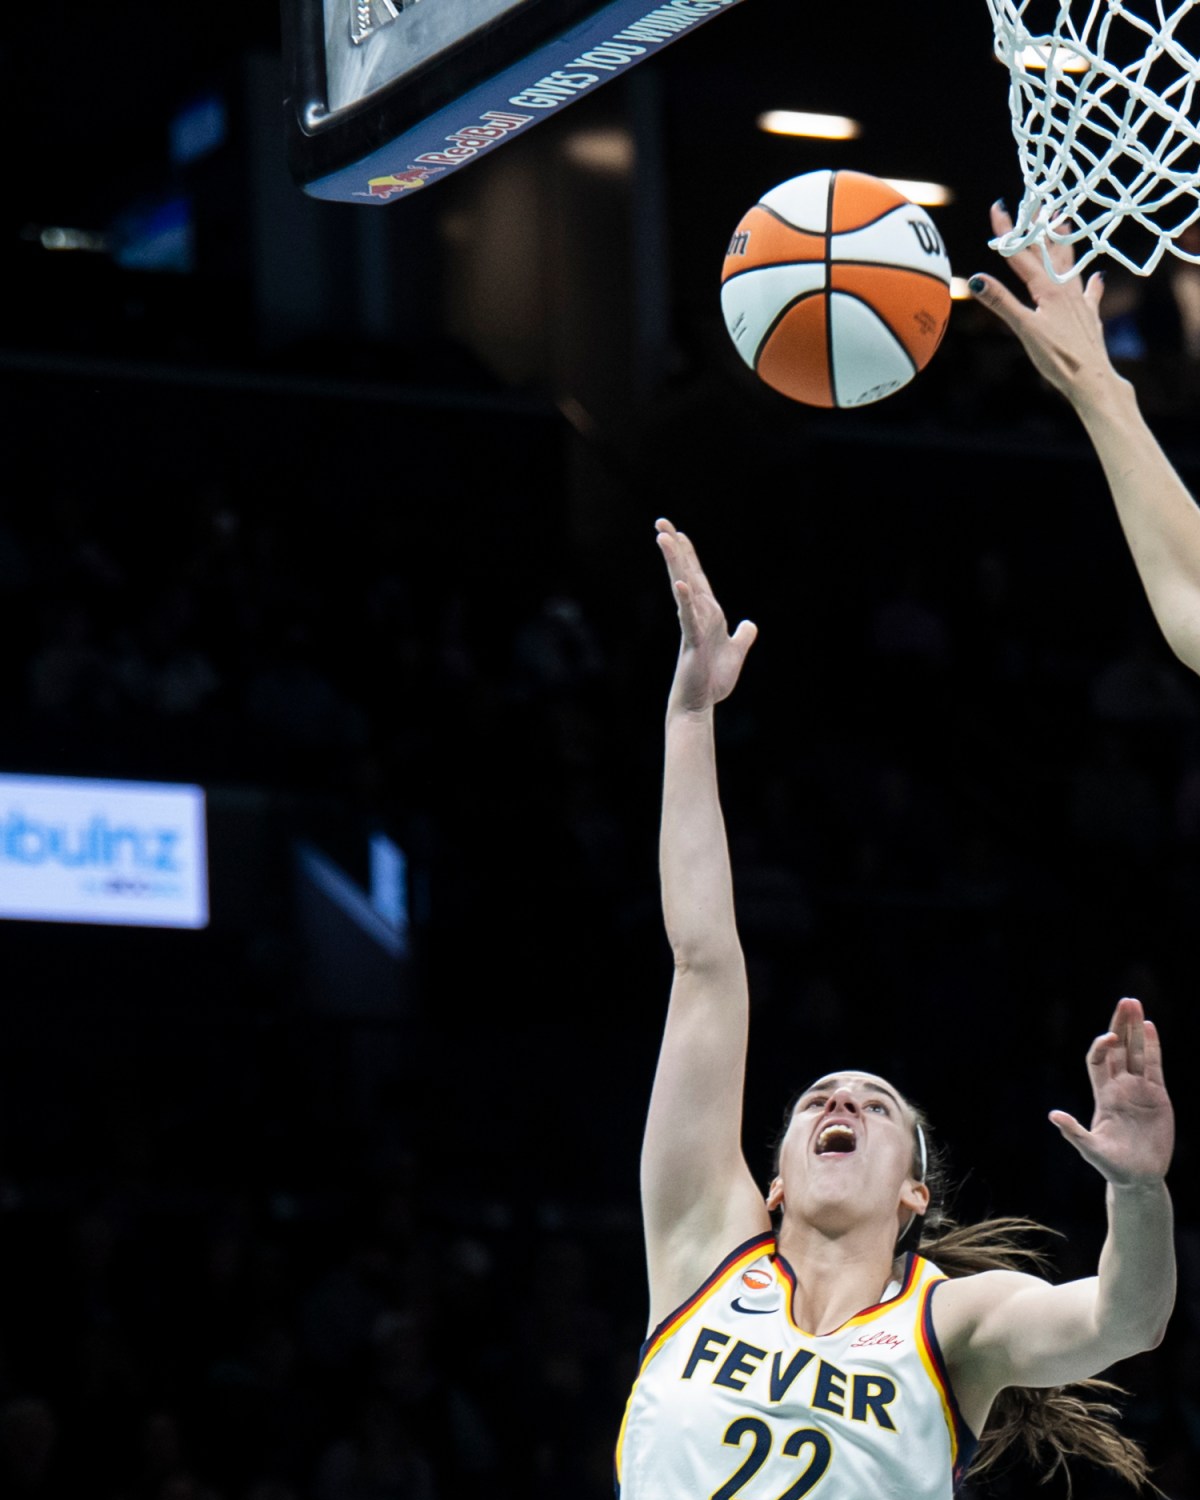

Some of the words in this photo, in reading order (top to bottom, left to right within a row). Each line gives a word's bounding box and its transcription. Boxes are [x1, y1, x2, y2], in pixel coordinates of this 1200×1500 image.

[508, 71, 599, 108] GIVES
[565, 42, 647, 70] YOU
[850, 1330, 905, 1350] Lilly
[681, 1326, 899, 1433] FEVER
